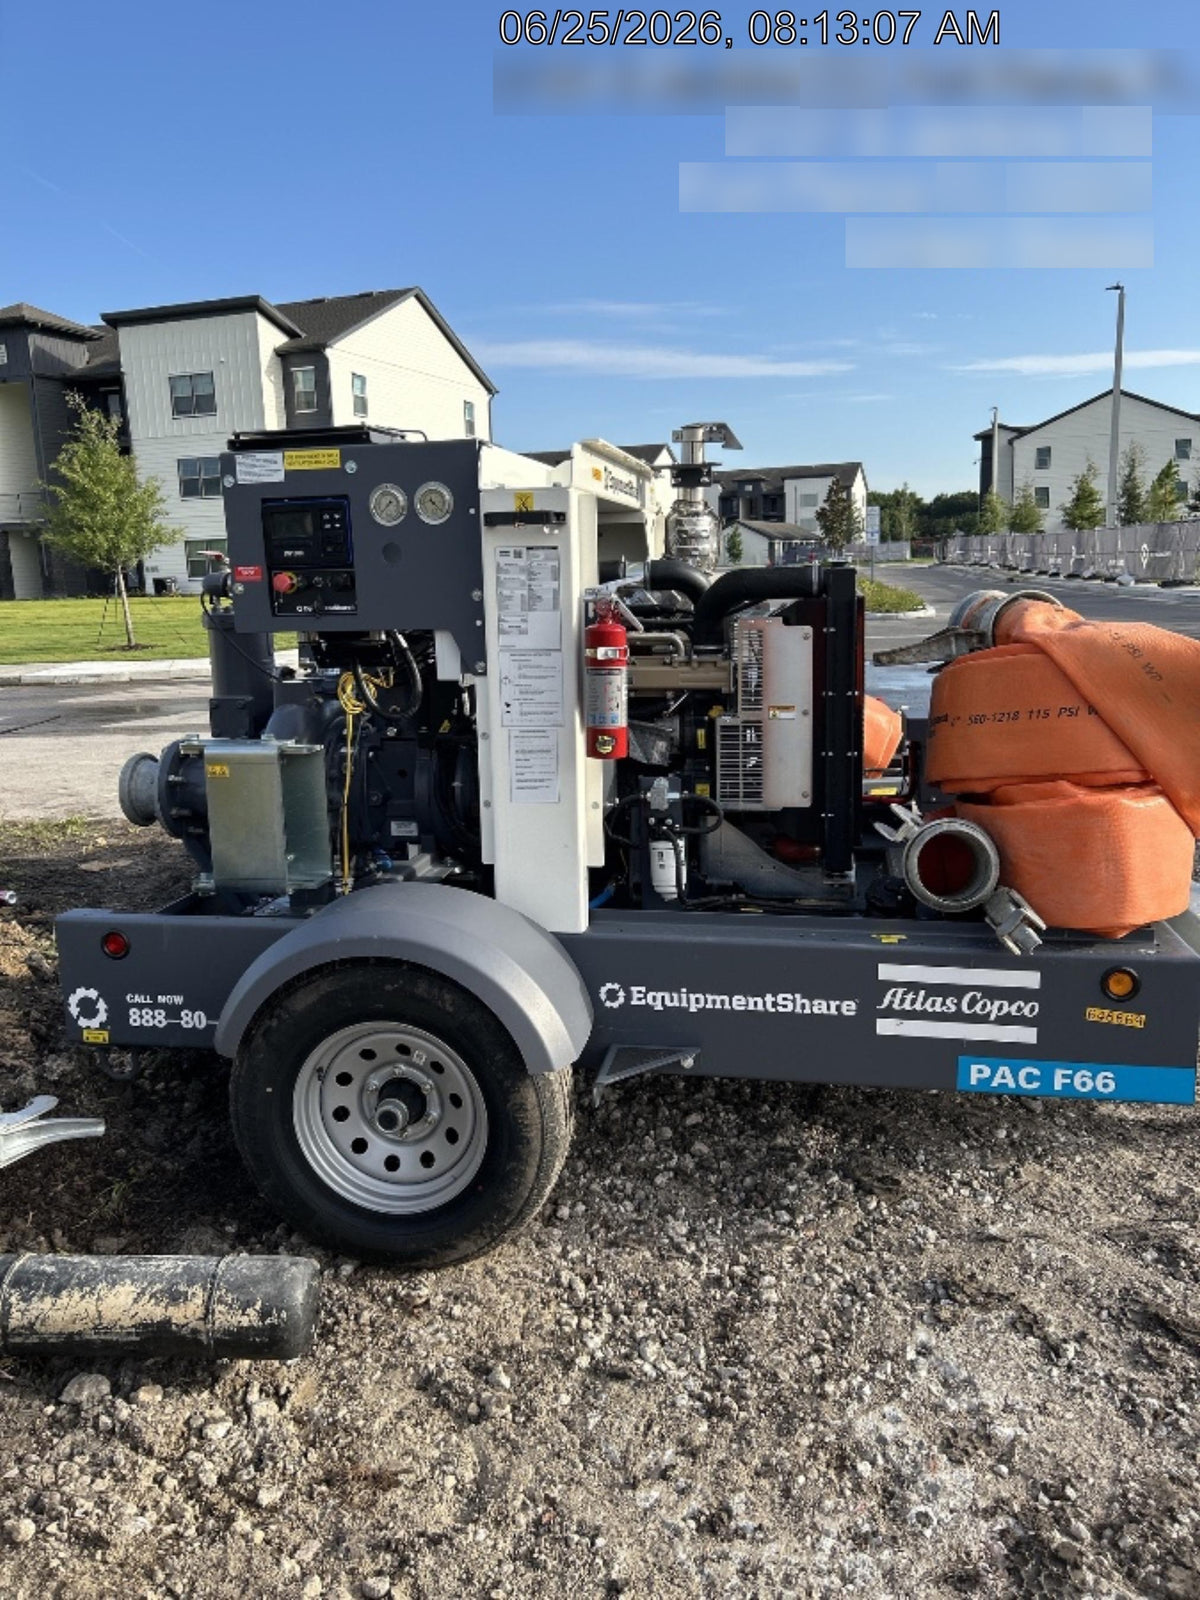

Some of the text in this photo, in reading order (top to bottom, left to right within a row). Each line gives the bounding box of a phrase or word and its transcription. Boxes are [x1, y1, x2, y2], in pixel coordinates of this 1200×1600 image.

[1057, 705, 1080, 718] PSI
[125, 993, 184, 1005] CALL NOW
[629, 985, 858, 1017] EquipmentShare
[876, 987, 1039, 1021] Atlas Copco
[969, 1063, 1117, 1094] PAC F66
